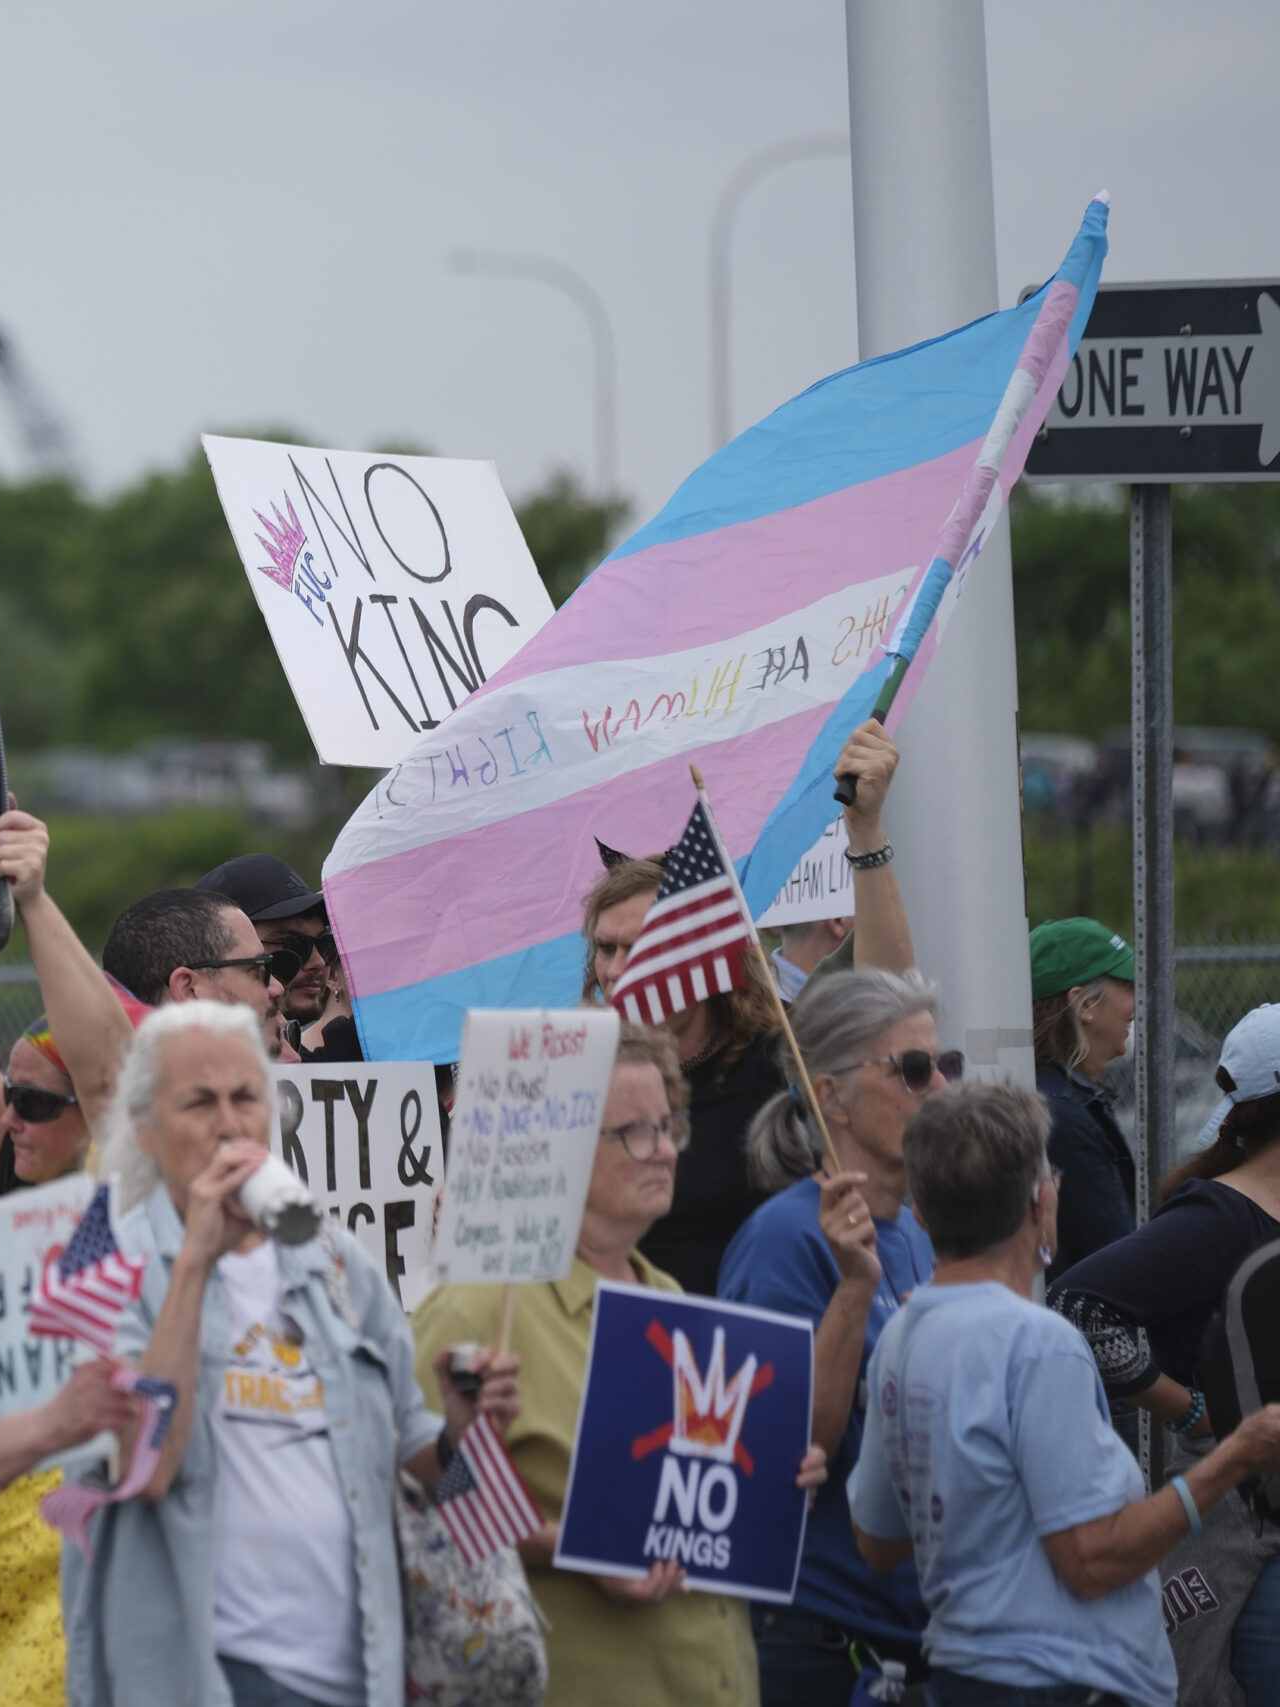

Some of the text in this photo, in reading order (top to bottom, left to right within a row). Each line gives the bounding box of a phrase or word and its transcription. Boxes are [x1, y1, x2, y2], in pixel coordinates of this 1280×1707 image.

[1057, 345, 1254, 418] ONE WAY
[287, 453, 453, 584] NO
[398, 1089, 434, 1188] &
[652, 1452, 739, 1534] NO
[642, 1522, 732, 1571] KINGS
